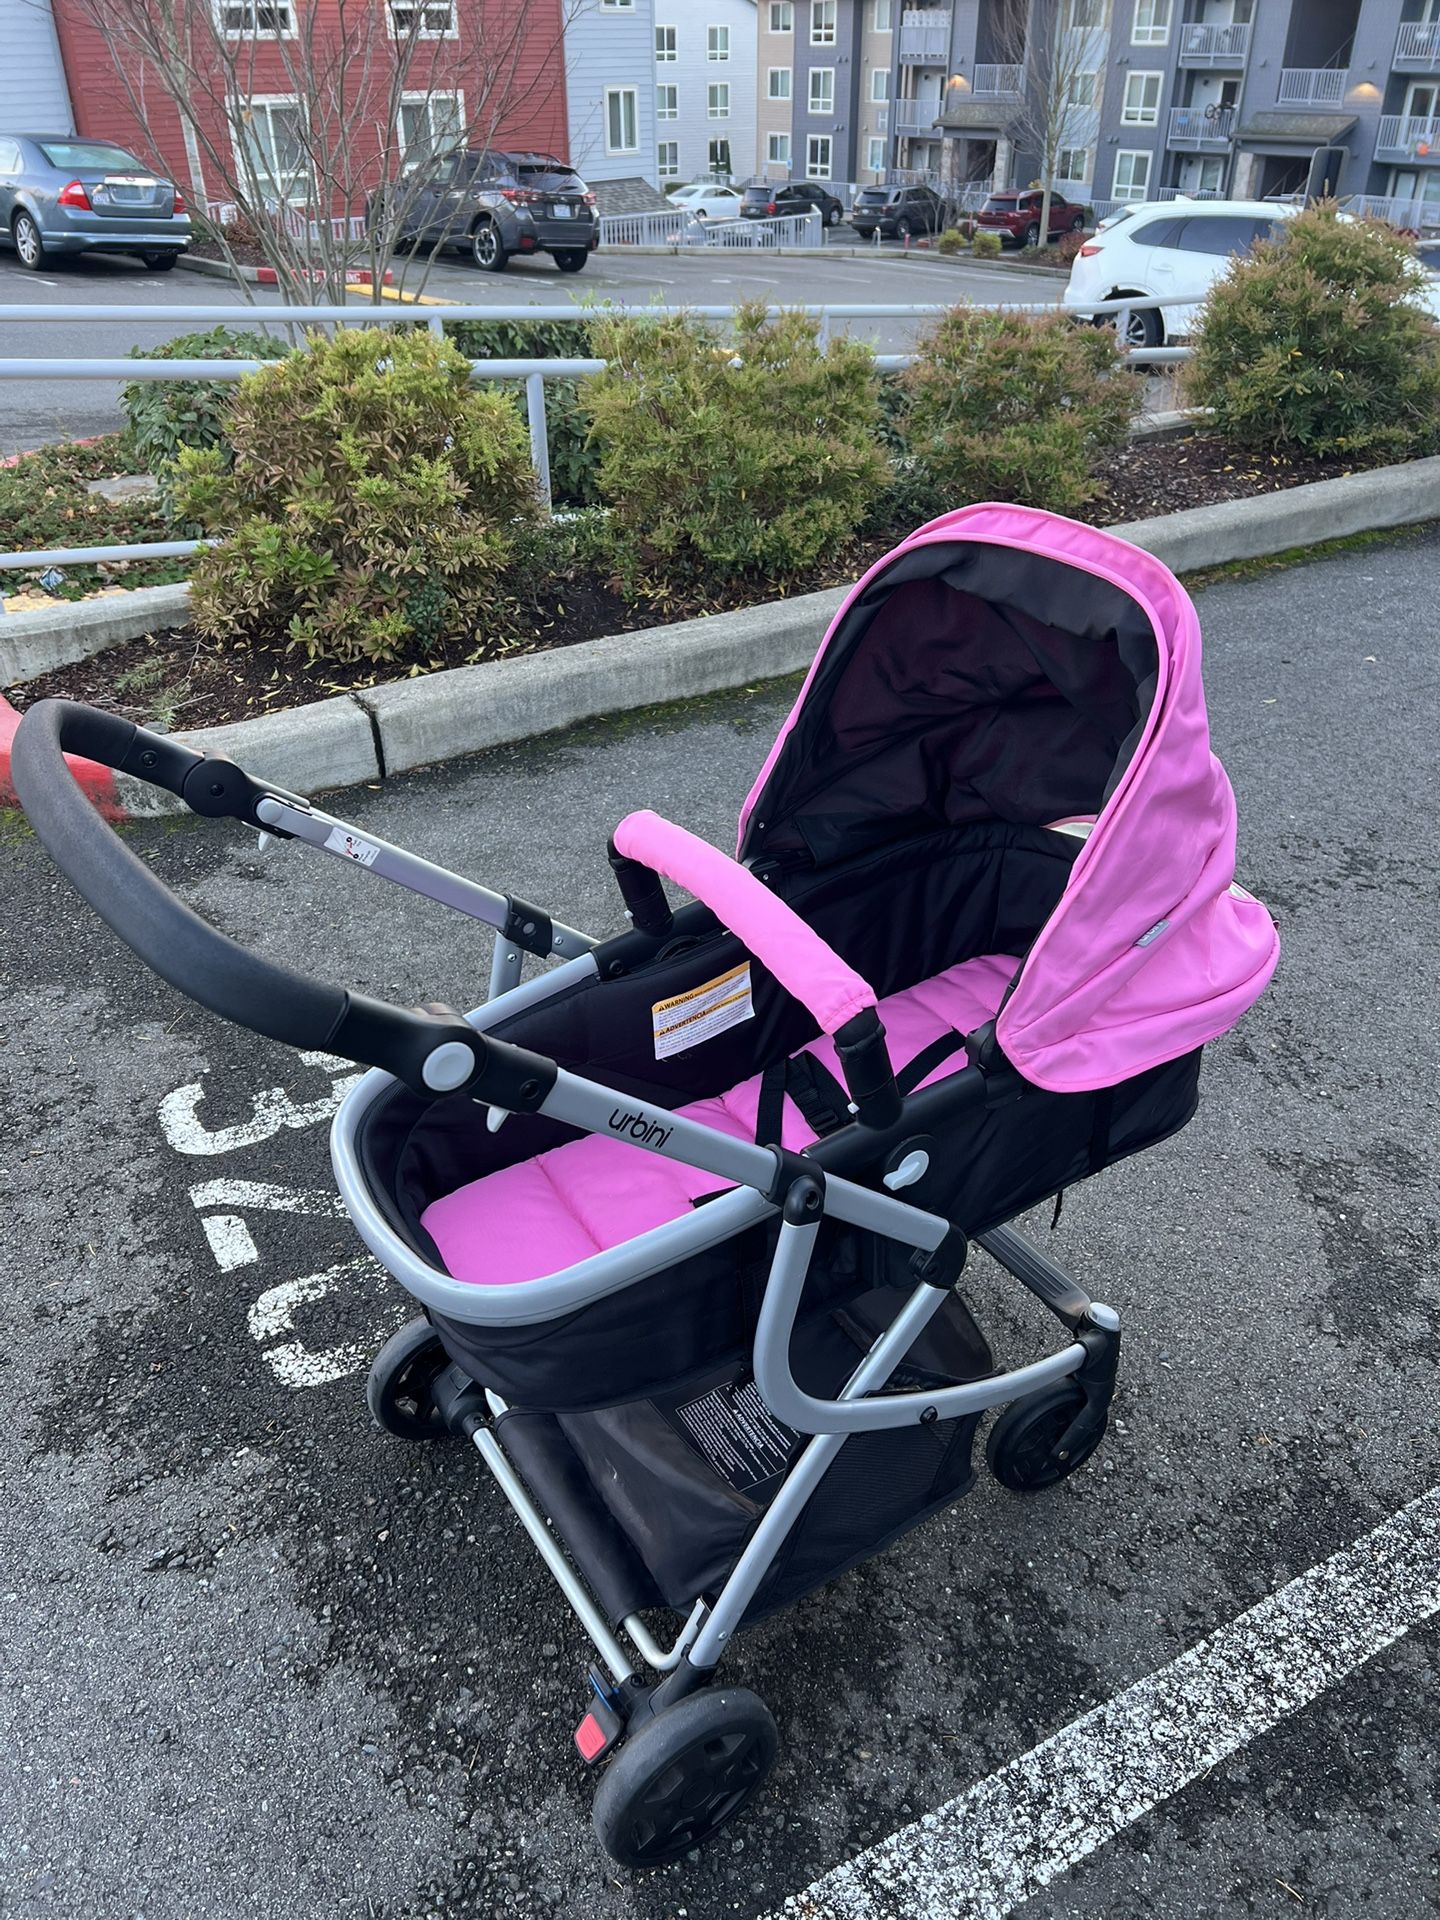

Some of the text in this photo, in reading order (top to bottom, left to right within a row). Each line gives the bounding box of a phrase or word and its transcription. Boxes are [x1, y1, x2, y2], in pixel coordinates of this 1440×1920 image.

[664, 993, 695, 1010] WARNING
[665, 1009, 707, 1033] ADVERTENCIA
[608, 1108, 674, 1149] urbini
